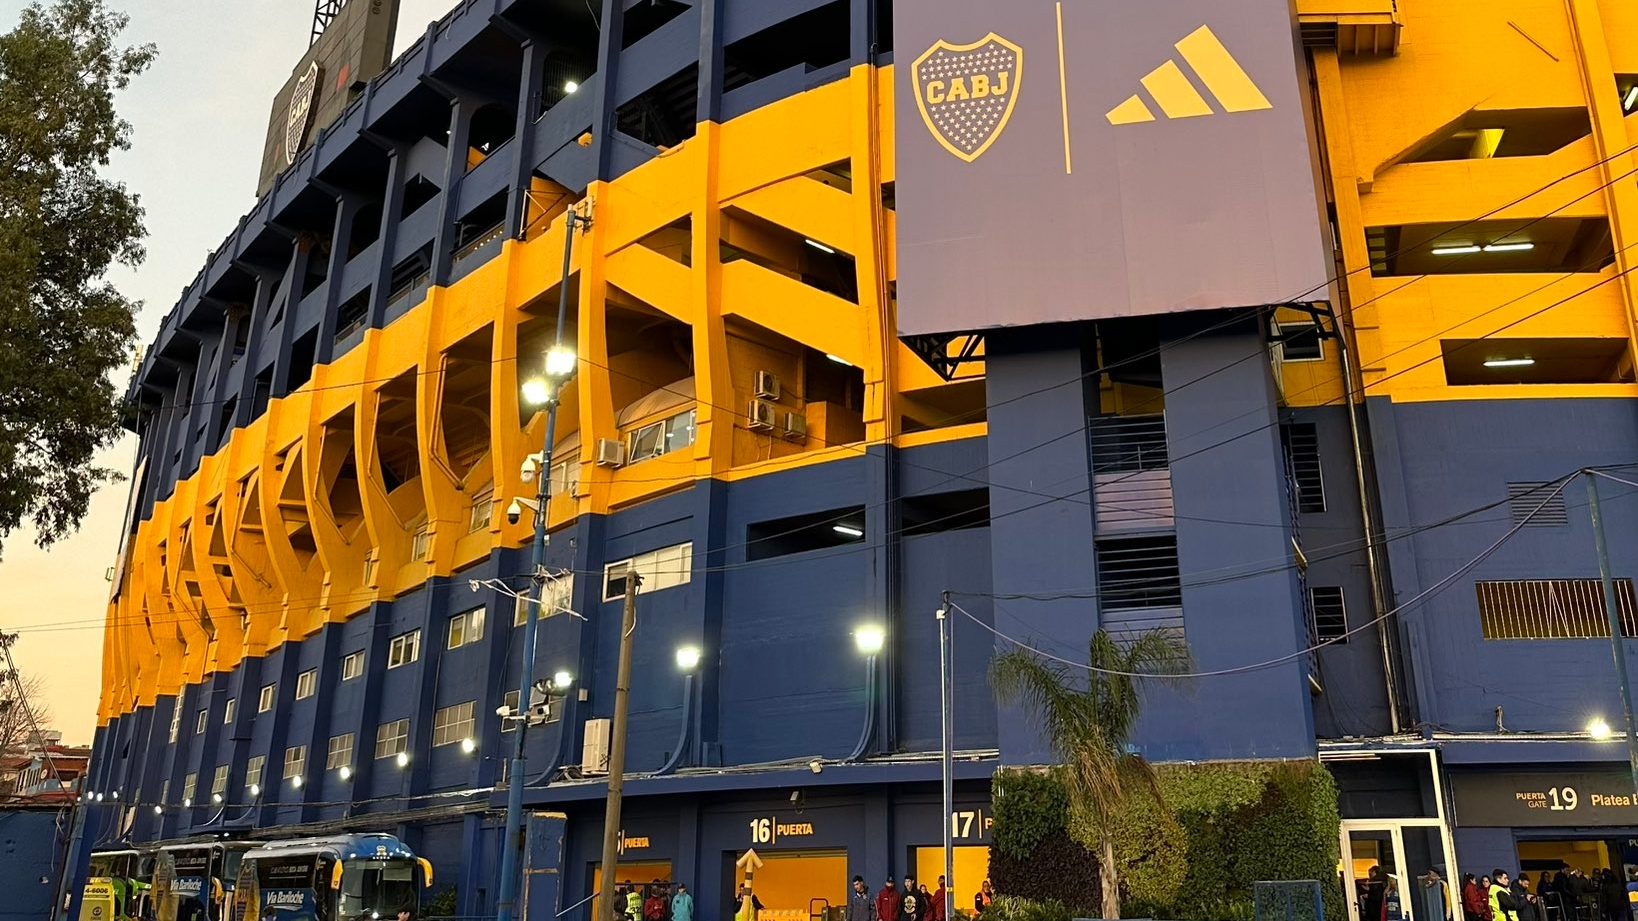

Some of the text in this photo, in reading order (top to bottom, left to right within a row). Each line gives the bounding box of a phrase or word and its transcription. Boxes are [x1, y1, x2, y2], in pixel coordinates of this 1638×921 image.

[926, 71, 1009, 104] CABJ
[1515, 792, 1547, 800] PUERTA
[1548, 786, 1578, 811] 19
[1590, 794, 1631, 806] Platea
[1527, 800, 1548, 809] GATE
[749, 818, 814, 843] 16 PUERTA
[951, 811, 975, 838] 17
[624, 837, 649, 848] PUERTA
[266, 890, 304, 905] Via Bariloche
